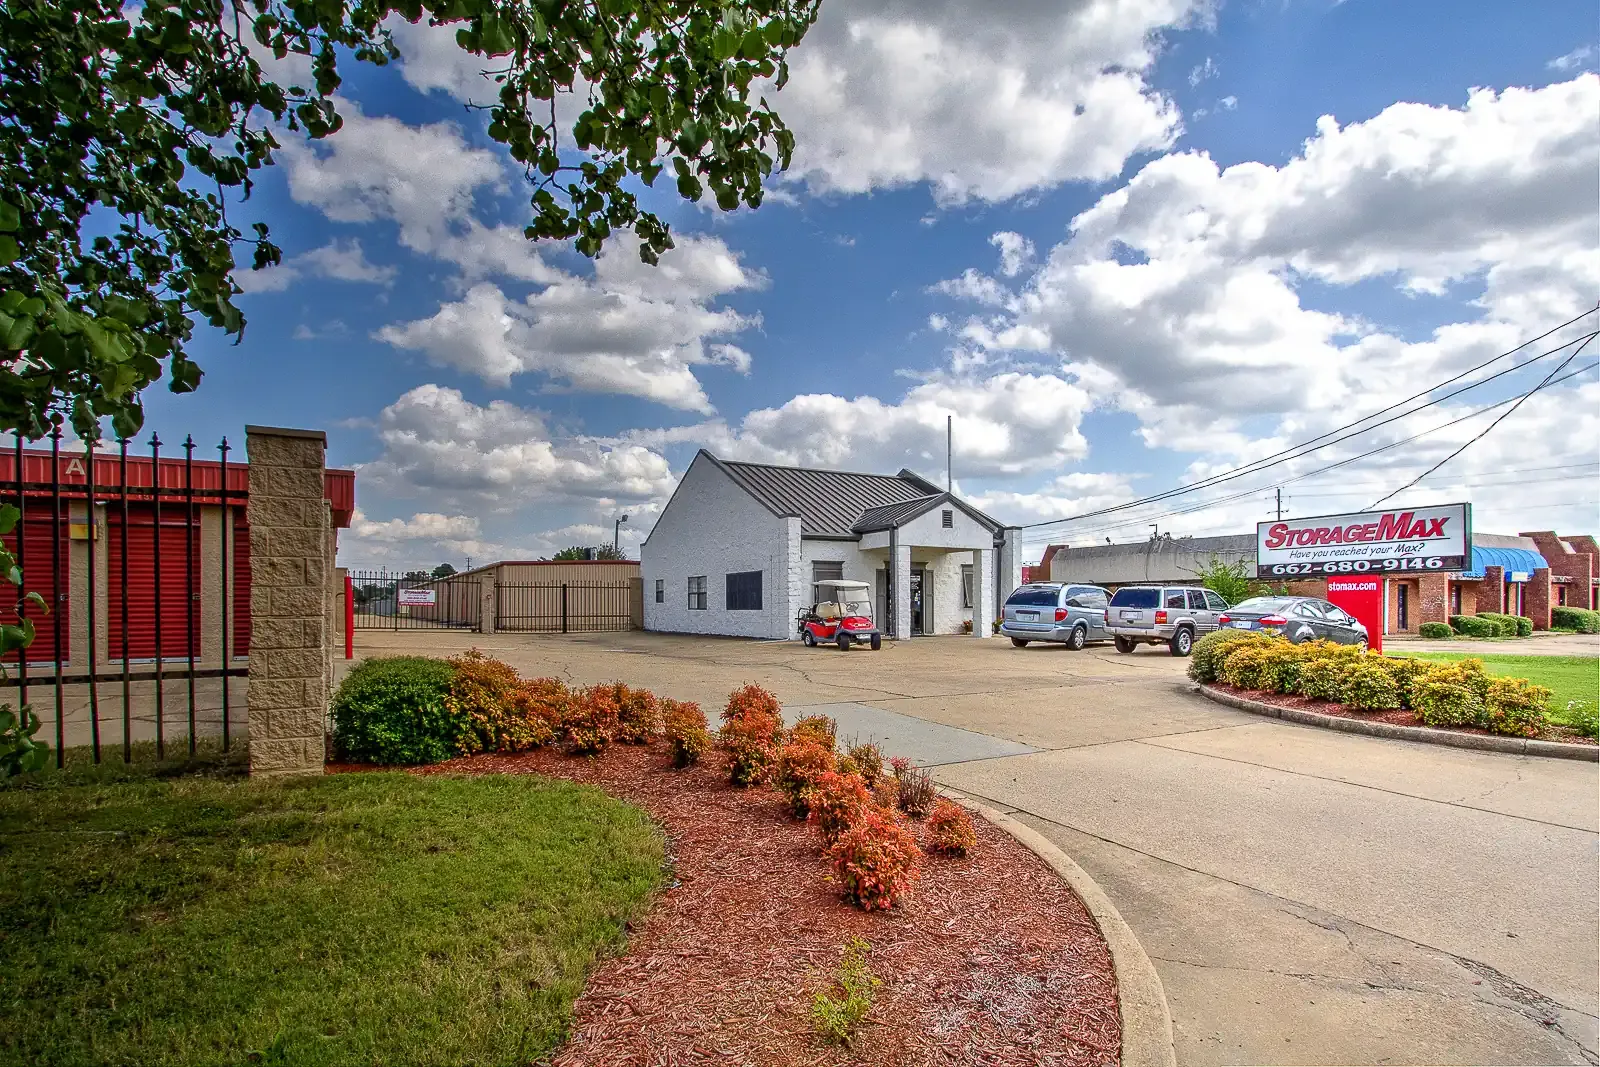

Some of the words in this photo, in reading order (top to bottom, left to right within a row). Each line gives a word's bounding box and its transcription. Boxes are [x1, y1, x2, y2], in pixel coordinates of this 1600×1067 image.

[65, 458, 85, 475] A
[1289, 550, 1311, 559] Have
[1312, 550, 1329, 562] you
[1330, 545, 1369, 557] reached
[1369, 546, 1393, 560] your
[1394, 542, 1426, 553] Max?
[1272, 556, 1443, 575] 662-680-9146
[1328, 581, 1377, 591] stomax.com
